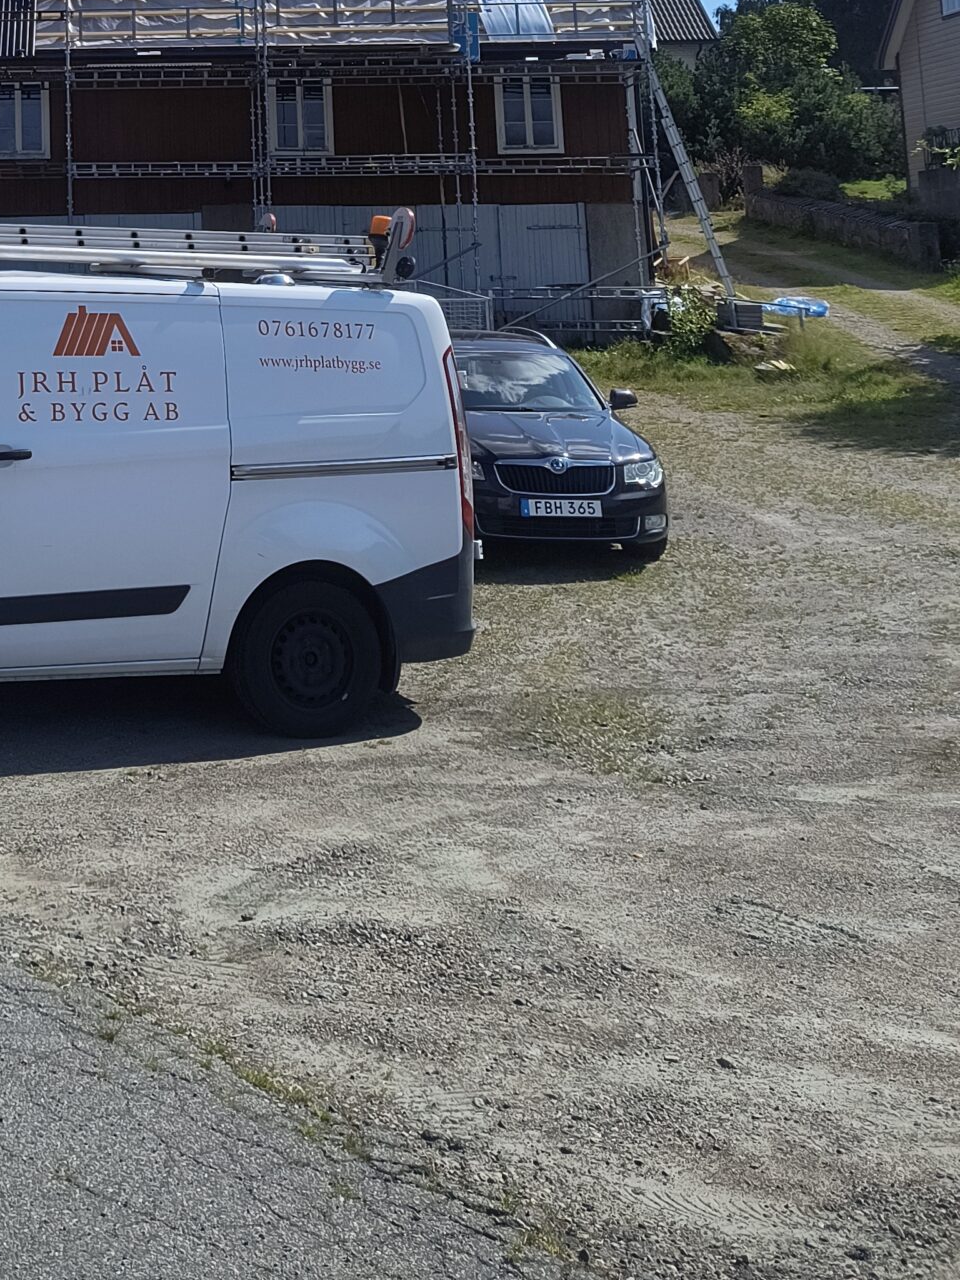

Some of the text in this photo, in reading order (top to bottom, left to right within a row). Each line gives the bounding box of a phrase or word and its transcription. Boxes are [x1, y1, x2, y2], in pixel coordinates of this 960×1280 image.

[258, 319, 375, 340] 0761678177
[259, 355, 382, 374] www.jrhplatbygg.se
[17, 365, 177, 399] JRH PLÅT
[18, 402, 179, 422] & BYGG AB
[534, 500, 596, 515] FBH 365
